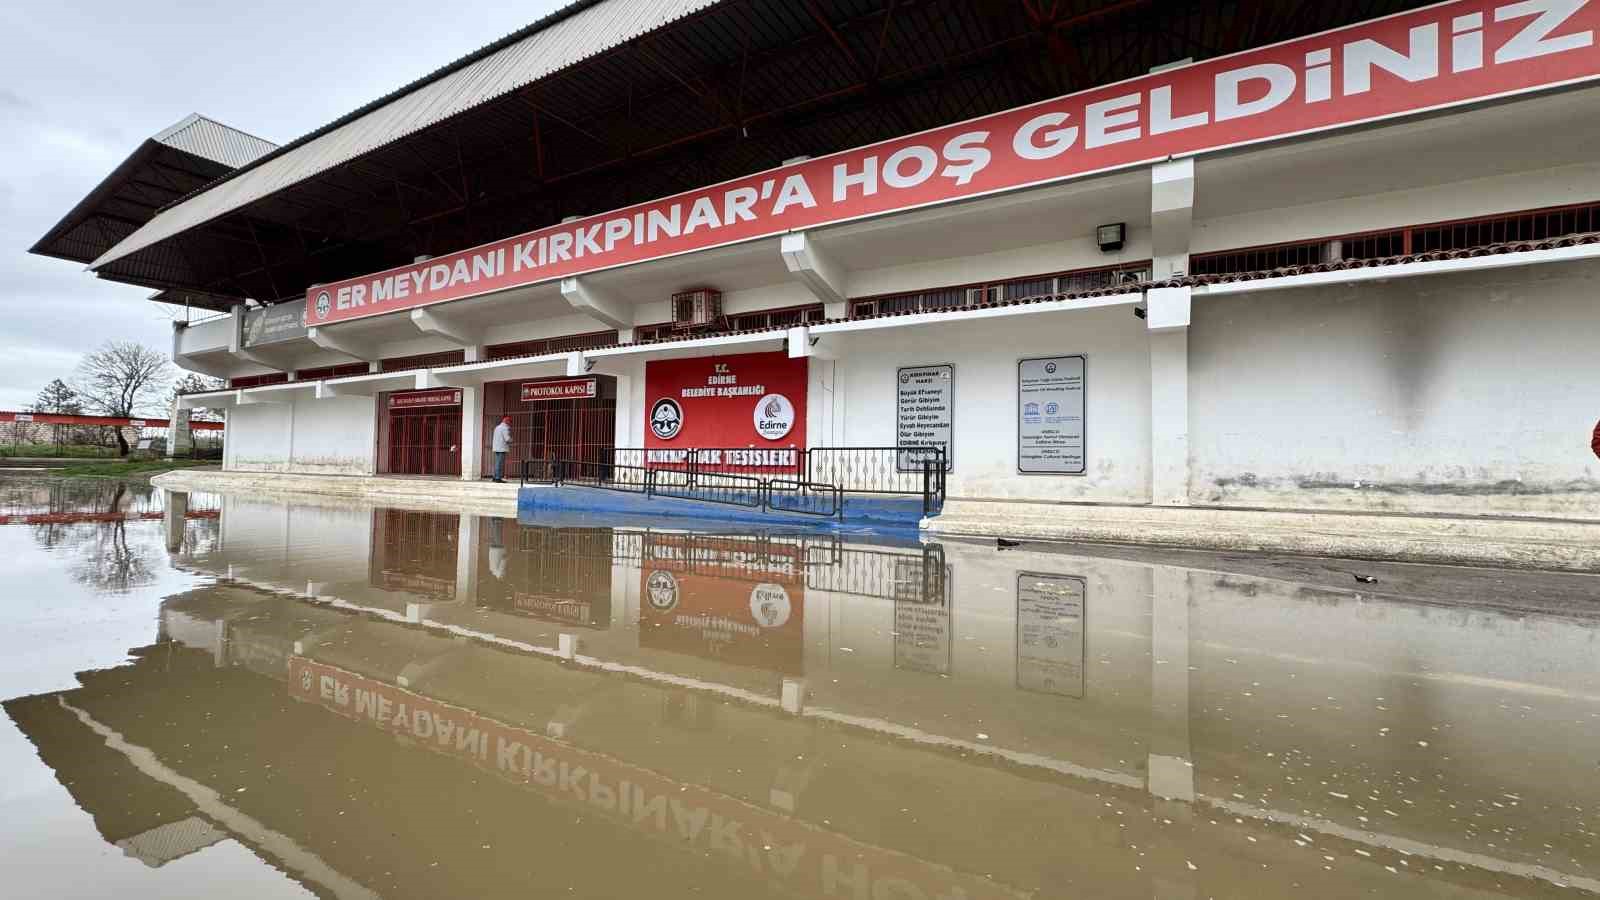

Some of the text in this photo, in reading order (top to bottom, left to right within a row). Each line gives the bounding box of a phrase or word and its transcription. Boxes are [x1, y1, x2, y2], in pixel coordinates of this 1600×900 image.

[336, 0, 1594, 310] ER MEYDANI KIRKPINAR'A HOŞ GELDİNİZ
[715, 364, 730, 373] T.C.
[708, 375, 736, 385] EDİRNE
[530, 385, 564, 396] PROTOKOL
[682, 384, 765, 398] BELEDİYE BAŞKANLIĞI
[760, 420, 787, 429] Edirne
[724, 444, 797, 466] TESİSLERİ
